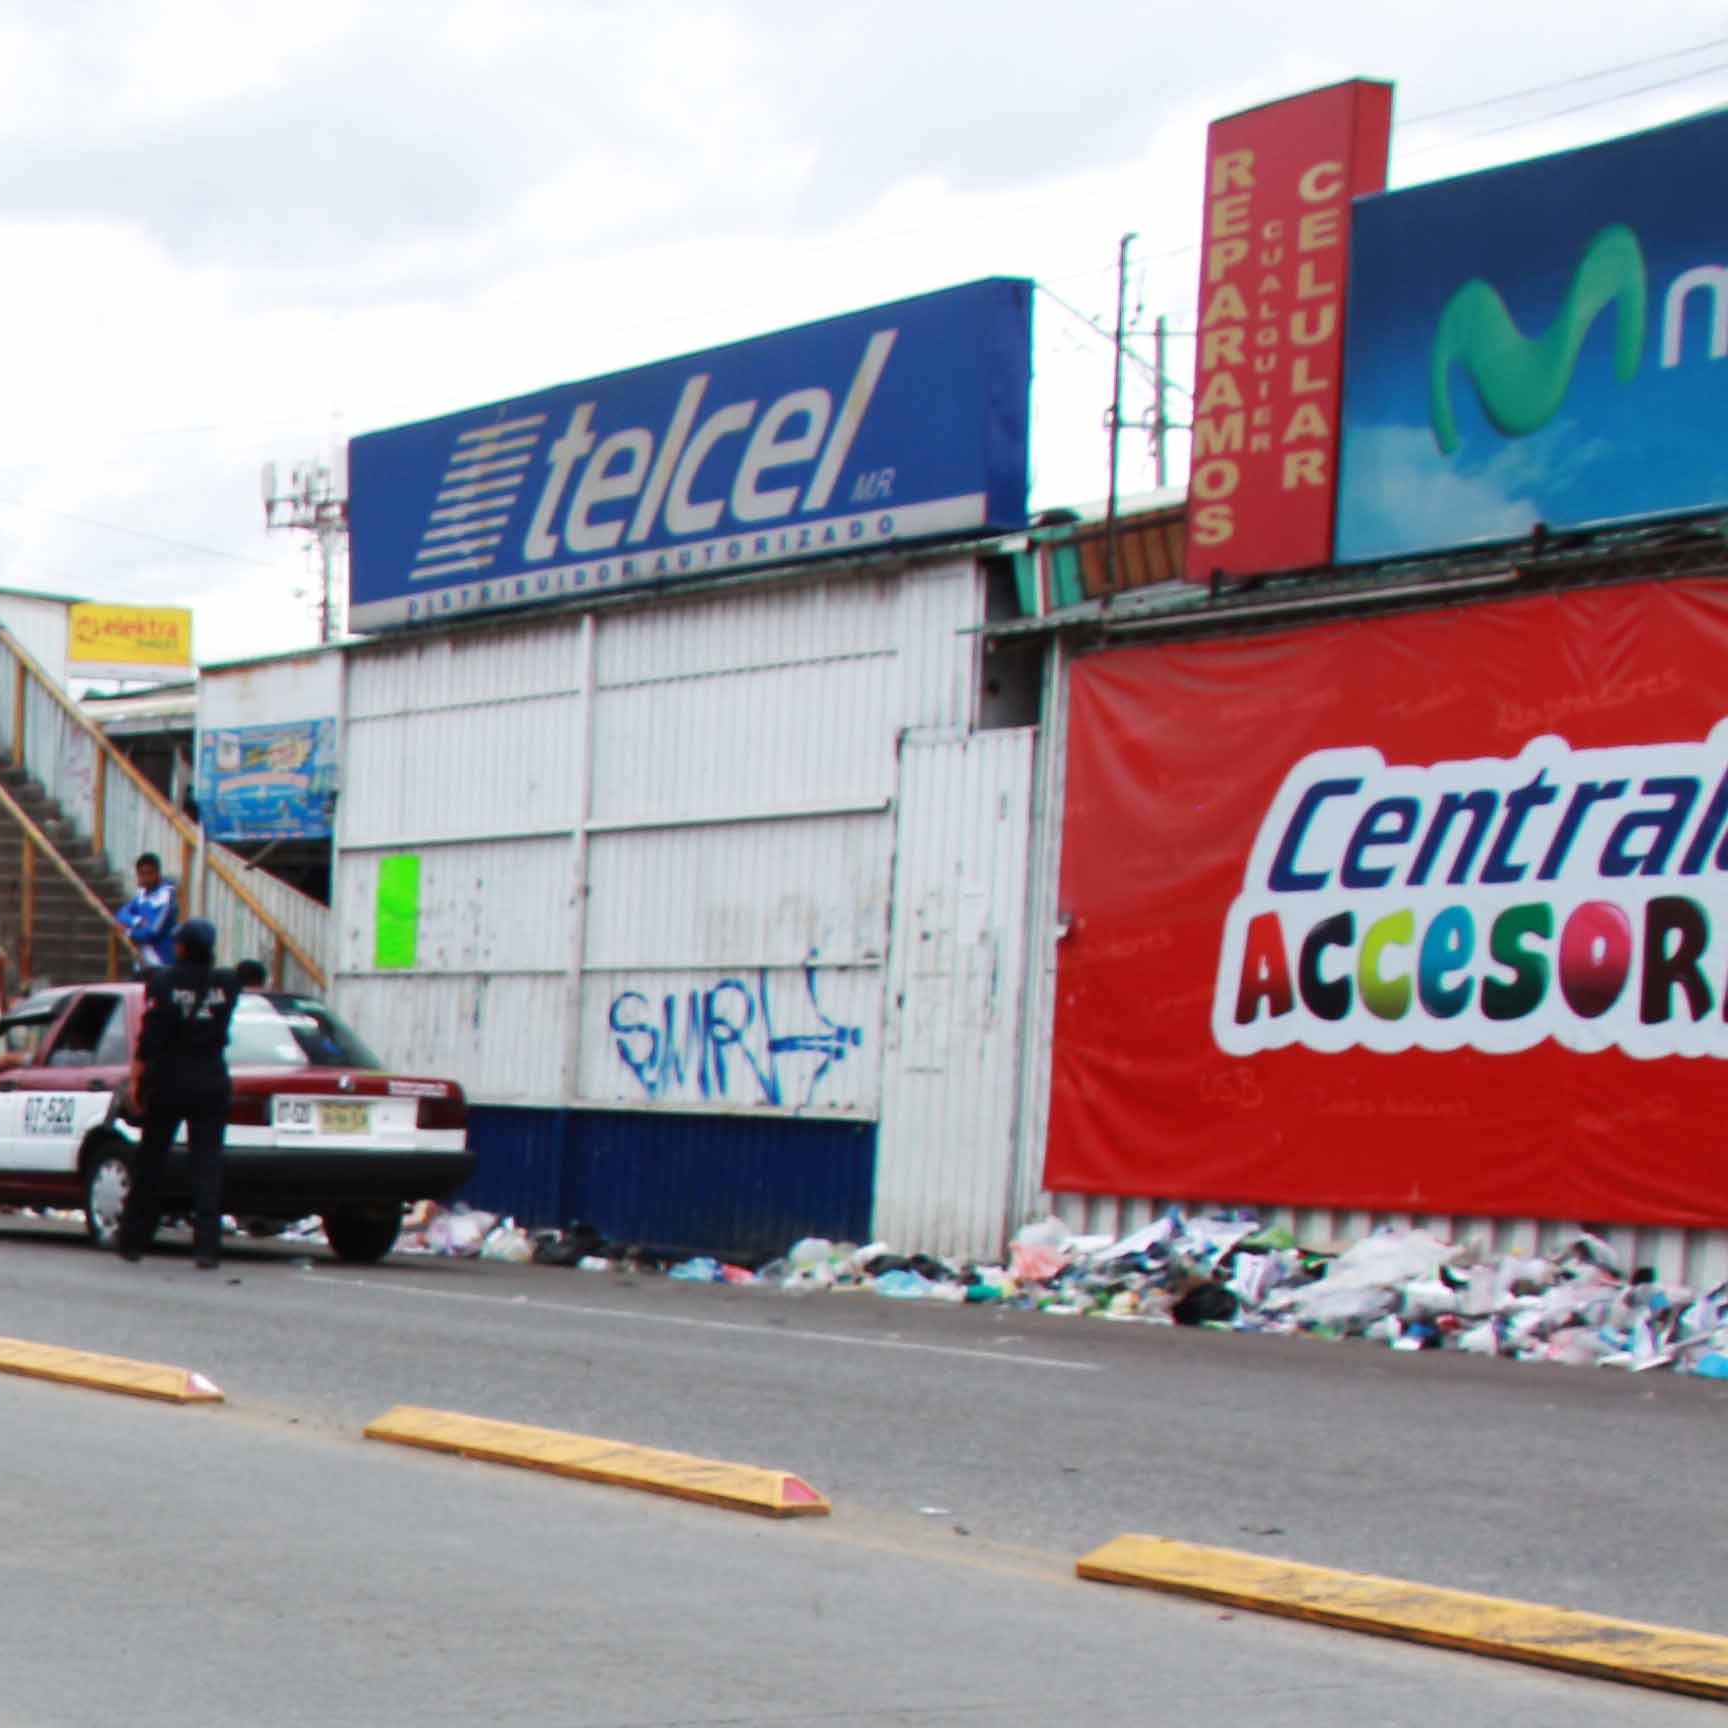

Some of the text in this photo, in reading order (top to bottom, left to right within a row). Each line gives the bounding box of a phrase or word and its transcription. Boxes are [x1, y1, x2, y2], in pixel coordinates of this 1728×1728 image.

[1194, 148, 1256, 546] REPARAMOS
[1249, 218, 1282, 452] CUALQUIER
[1281, 161, 1345, 490] CELULAR
[523, 328, 899, 562] telcel
[406, 514, 896, 616] DISTRIBUIDOR AUTORIZADO
[1266, 765, 1728, 894] Central
